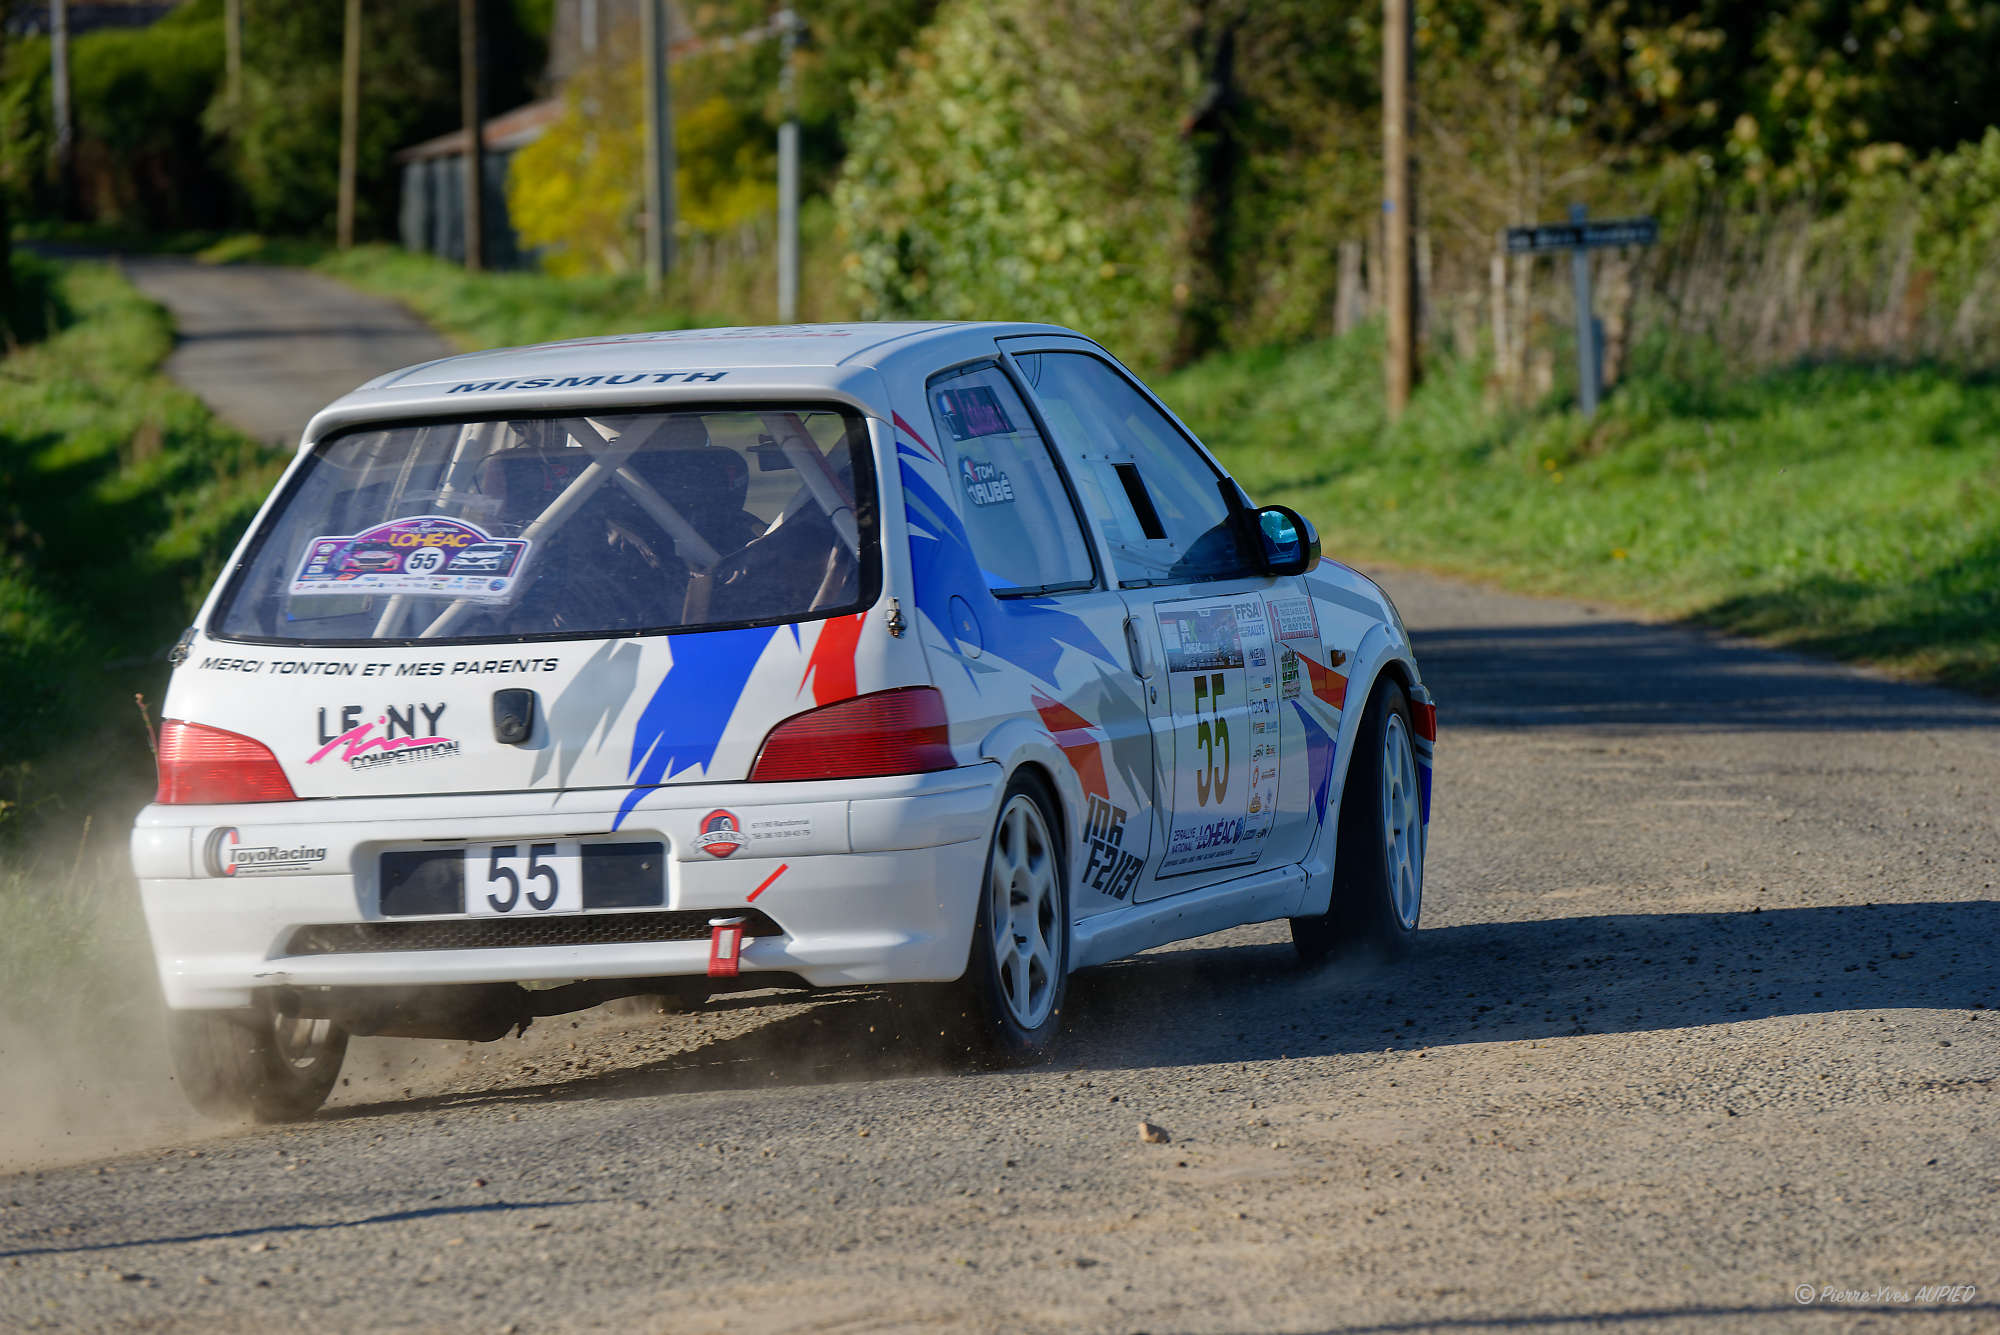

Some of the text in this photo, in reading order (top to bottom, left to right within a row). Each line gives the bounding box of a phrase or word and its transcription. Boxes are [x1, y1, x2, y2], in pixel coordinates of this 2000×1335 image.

[446, 371, 729, 394] MISMUTH
[975, 465, 994, 479] TOM
[390, 532, 472, 548] LOHÉAC
[410, 553, 438, 569] 55
[1234, 602, 1258, 619] FFSA
[201, 658, 558, 676] MERCI TONTON ET MES PARENTS
[1194, 672, 1229, 808] 55
[351, 741, 459, 768] COMPETITION
[1083, 796, 1126, 847] 106
[1197, 818, 1236, 850] LOHÉAC
[231, 845, 327, 866] ToyoRacing
[487, 844, 560, 915] 55
[1081, 838, 1145, 900] F2/13
